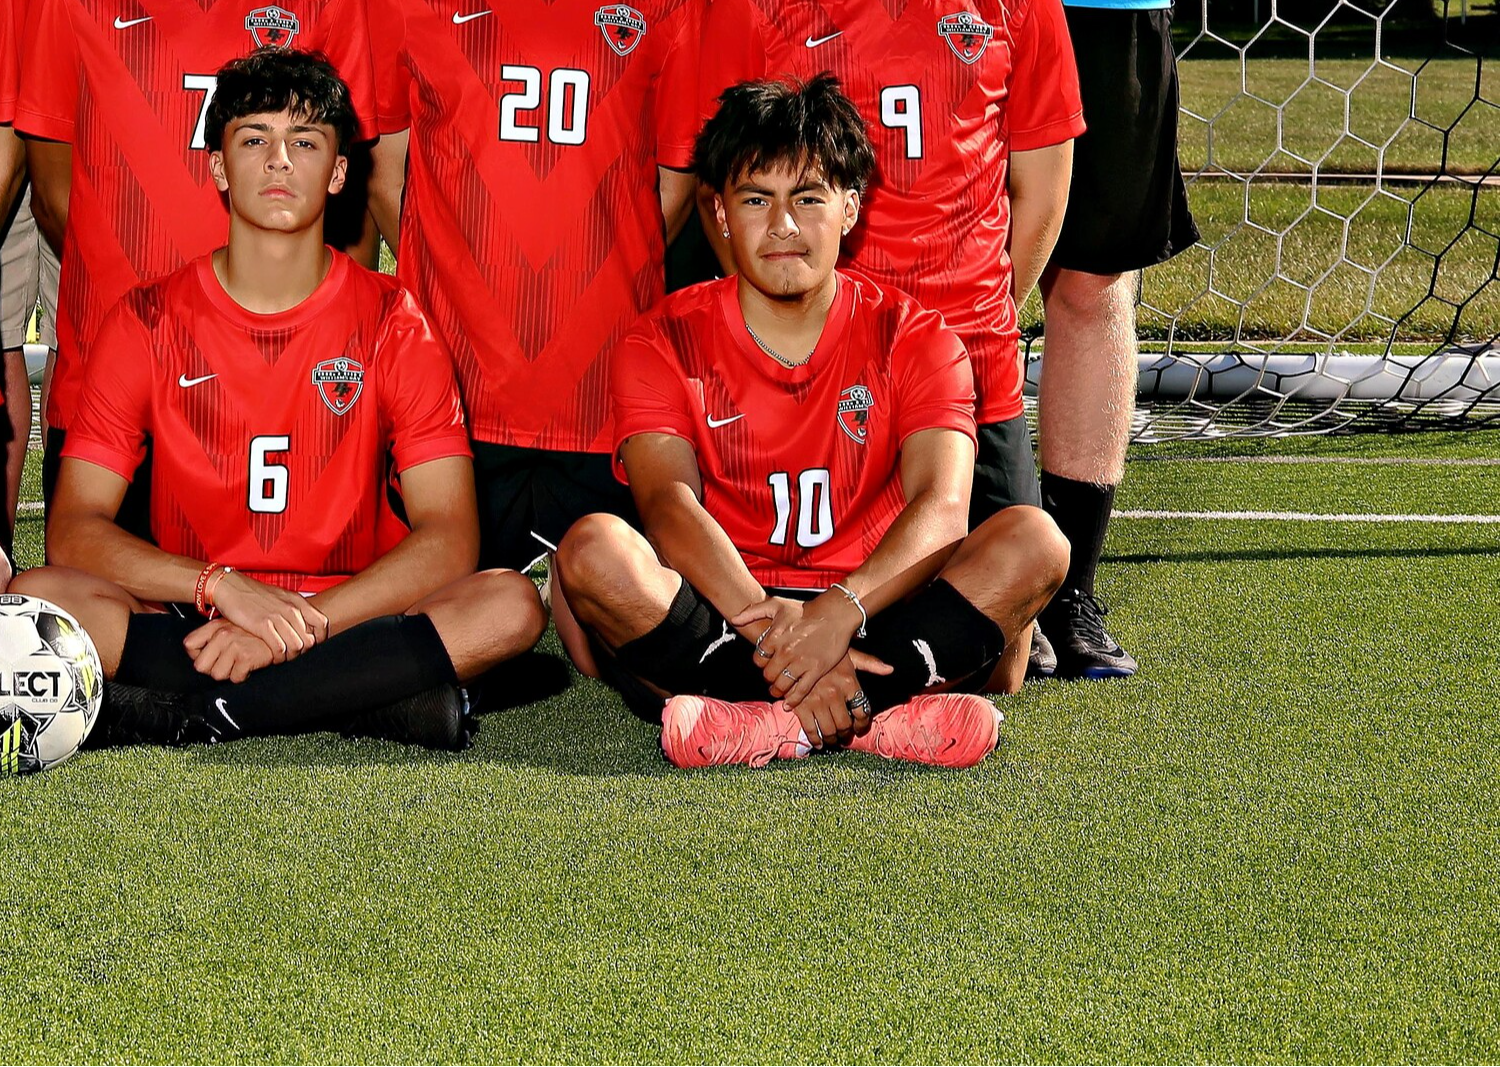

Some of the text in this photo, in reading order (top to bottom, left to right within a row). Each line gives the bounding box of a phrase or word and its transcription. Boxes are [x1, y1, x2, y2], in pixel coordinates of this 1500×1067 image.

[182, 74, 218, 150] 7
[498, 64, 591, 146] 20
[879, 83, 923, 160] 9
[247, 434, 291, 515] 6
[767, 467, 836, 549] 10
